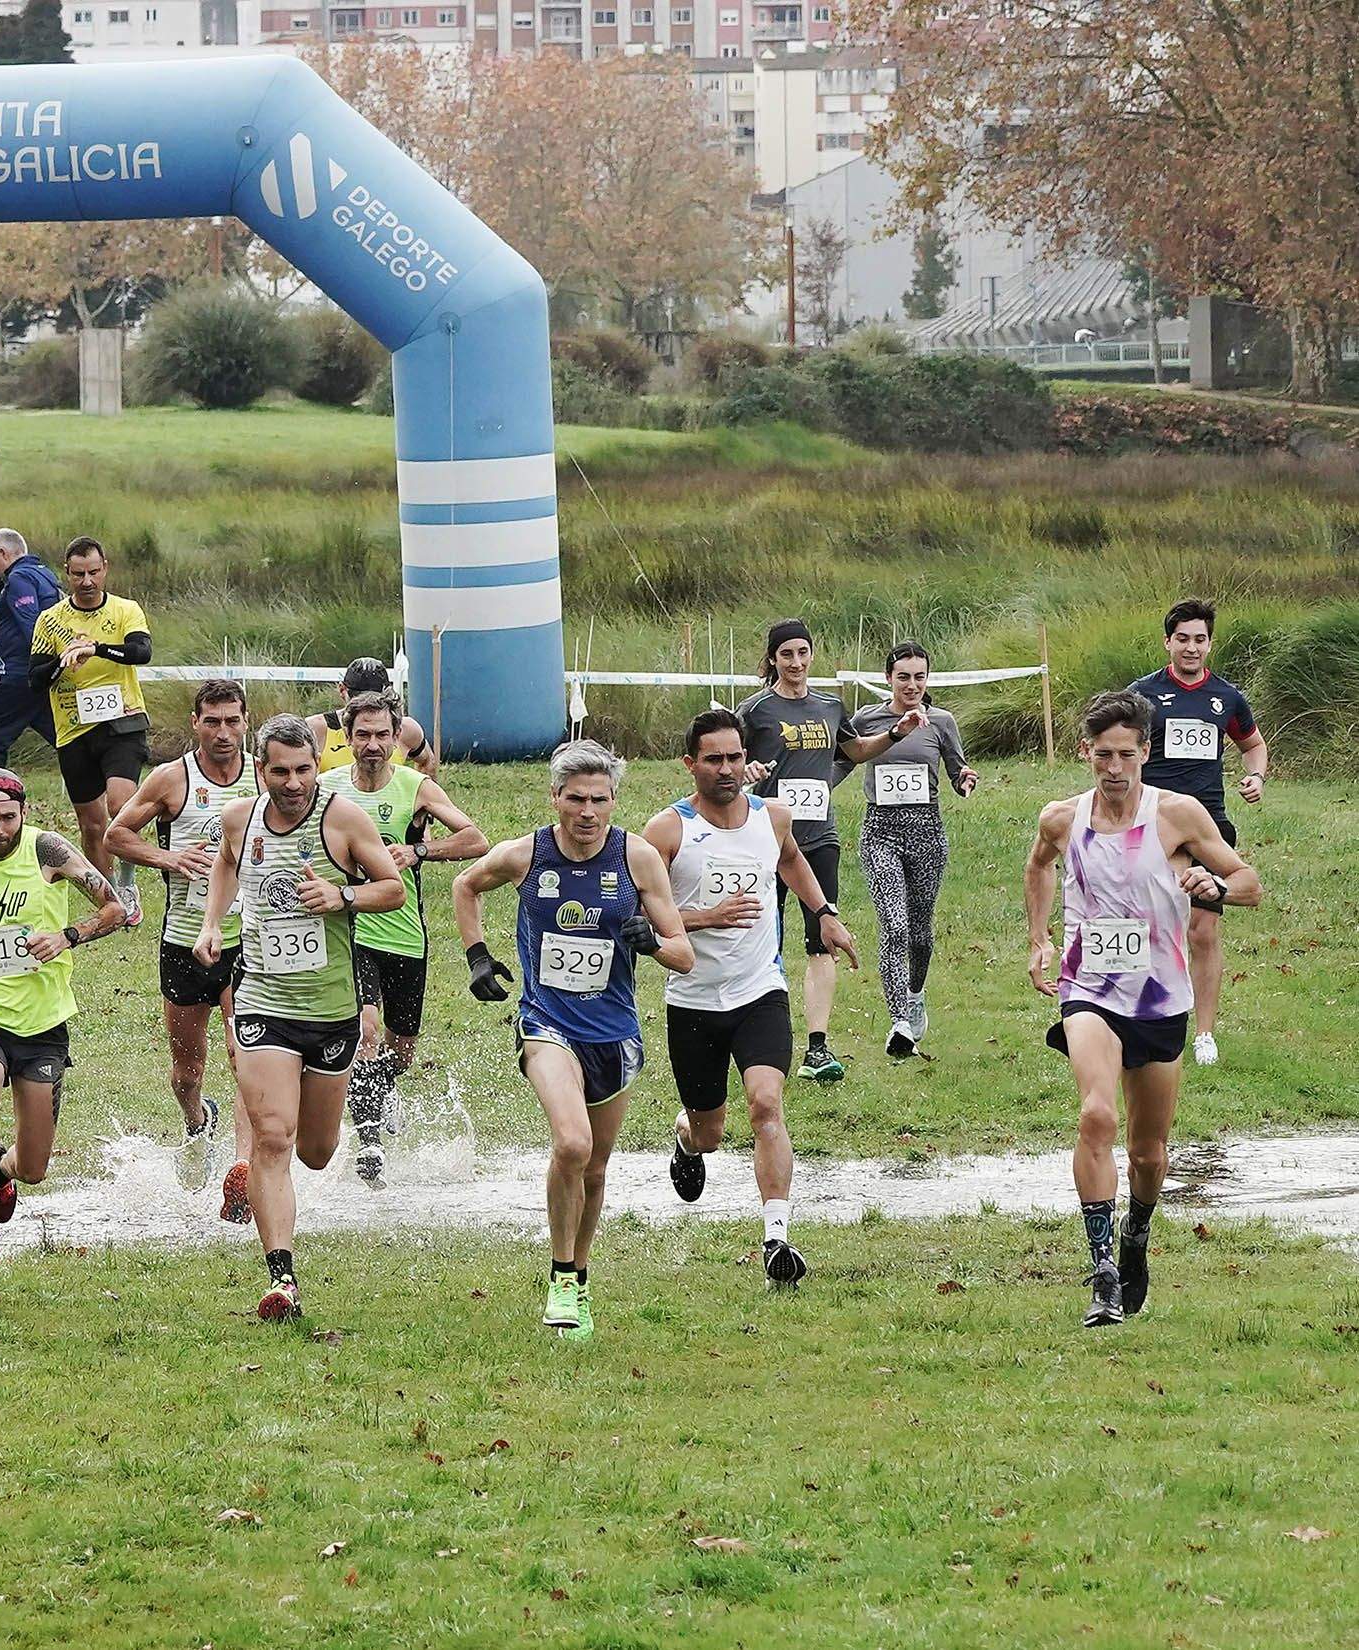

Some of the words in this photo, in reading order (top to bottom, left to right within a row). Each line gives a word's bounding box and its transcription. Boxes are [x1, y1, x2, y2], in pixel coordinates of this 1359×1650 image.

[347, 185, 459, 285] DEPORTE
[332, 205, 427, 291] GALEGO
[83, 693, 118, 712] 328
[802, 740, 826, 749] BRUXA
[1171, 728, 1211, 746] 368
[883, 774, 922, 792] 365
[786, 789, 824, 807] 323
[709, 872, 758, 894] 332
[6, 891, 28, 917] UP
[561, 908, 580, 925] Ulla
[584, 908, 602, 925] Oil
[268, 931, 319, 957] 336
[1090, 932, 1141, 955] 340
[549, 948, 604, 975] 329
